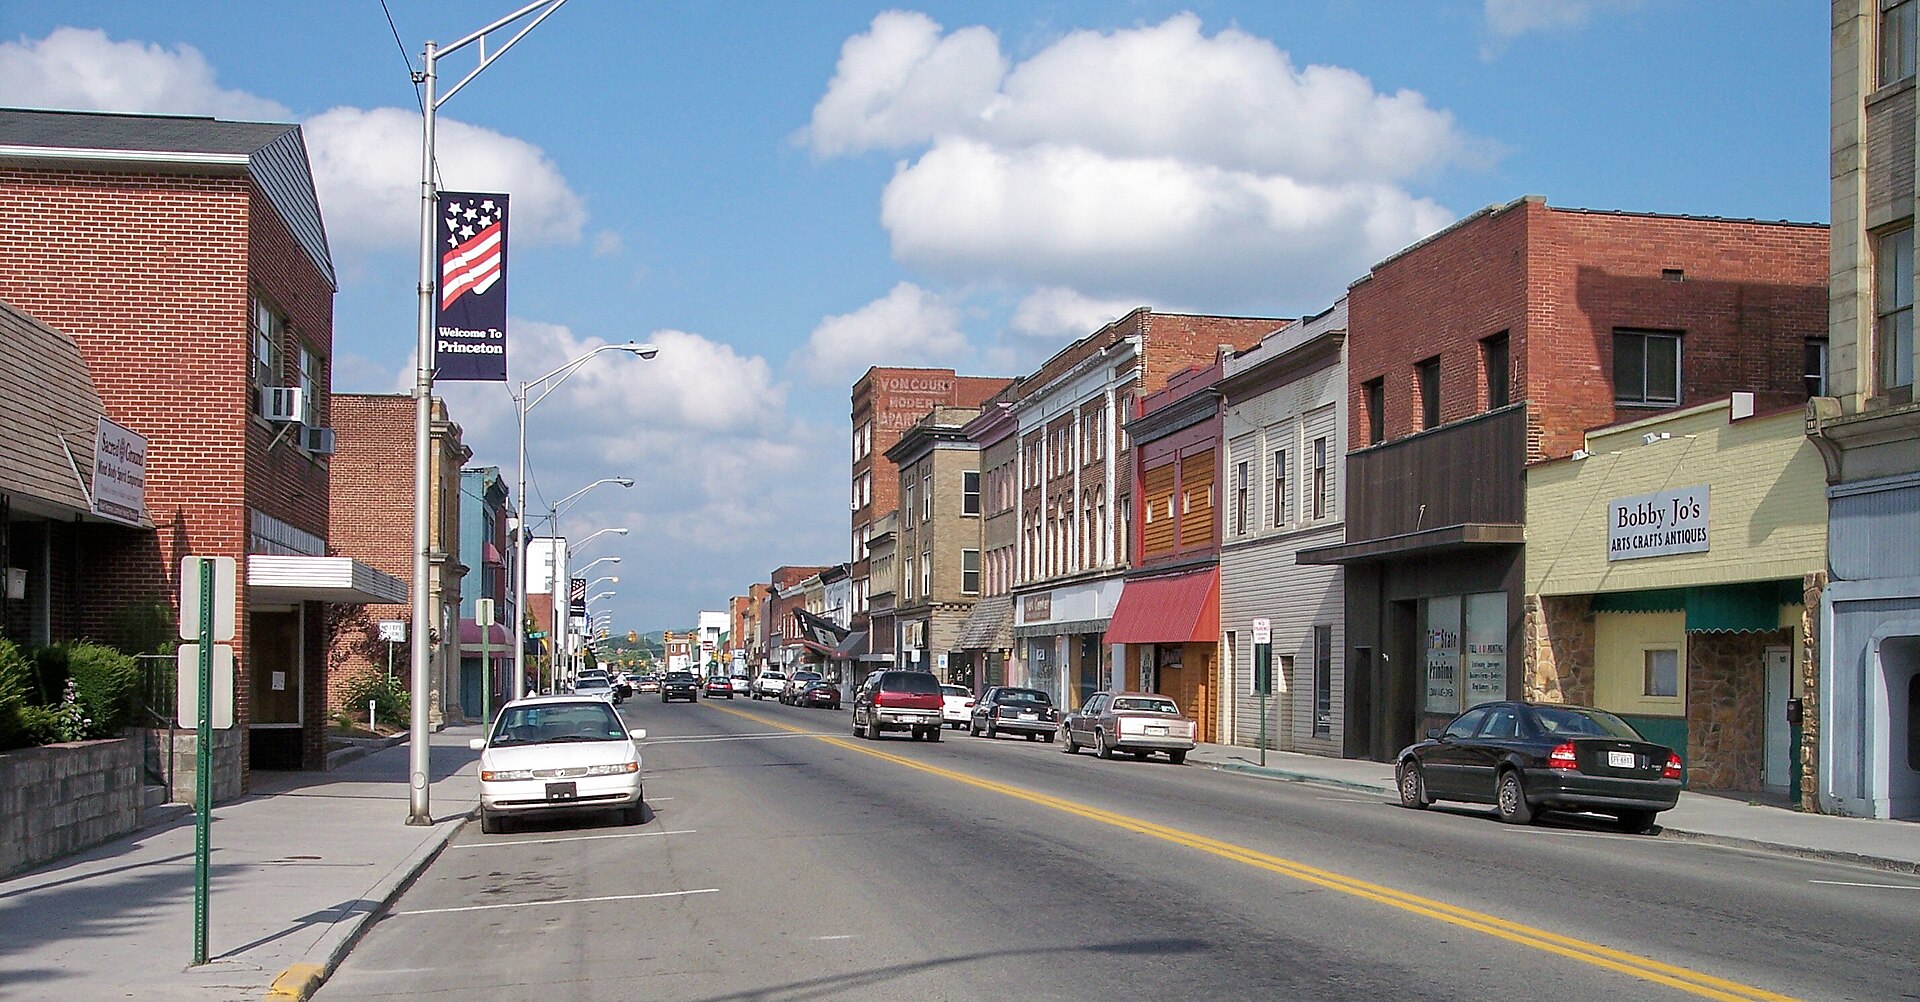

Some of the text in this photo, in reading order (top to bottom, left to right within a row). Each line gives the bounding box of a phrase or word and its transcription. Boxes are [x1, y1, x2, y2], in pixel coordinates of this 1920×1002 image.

[438, 327, 503, 339] Welcome To
[437, 341, 503, 354] Princeton
[102, 432, 144, 467] Sacred Ground
[98, 458, 144, 488] Mind Body Spirit Emporium
[1617, 496, 1700, 529] Bobby Jo's
[1611, 527, 1707, 552] ARTS CRAFTS ANTIQUES
[1441, 628, 1457, 649] State
[1429, 660, 1453, 684] Printing
